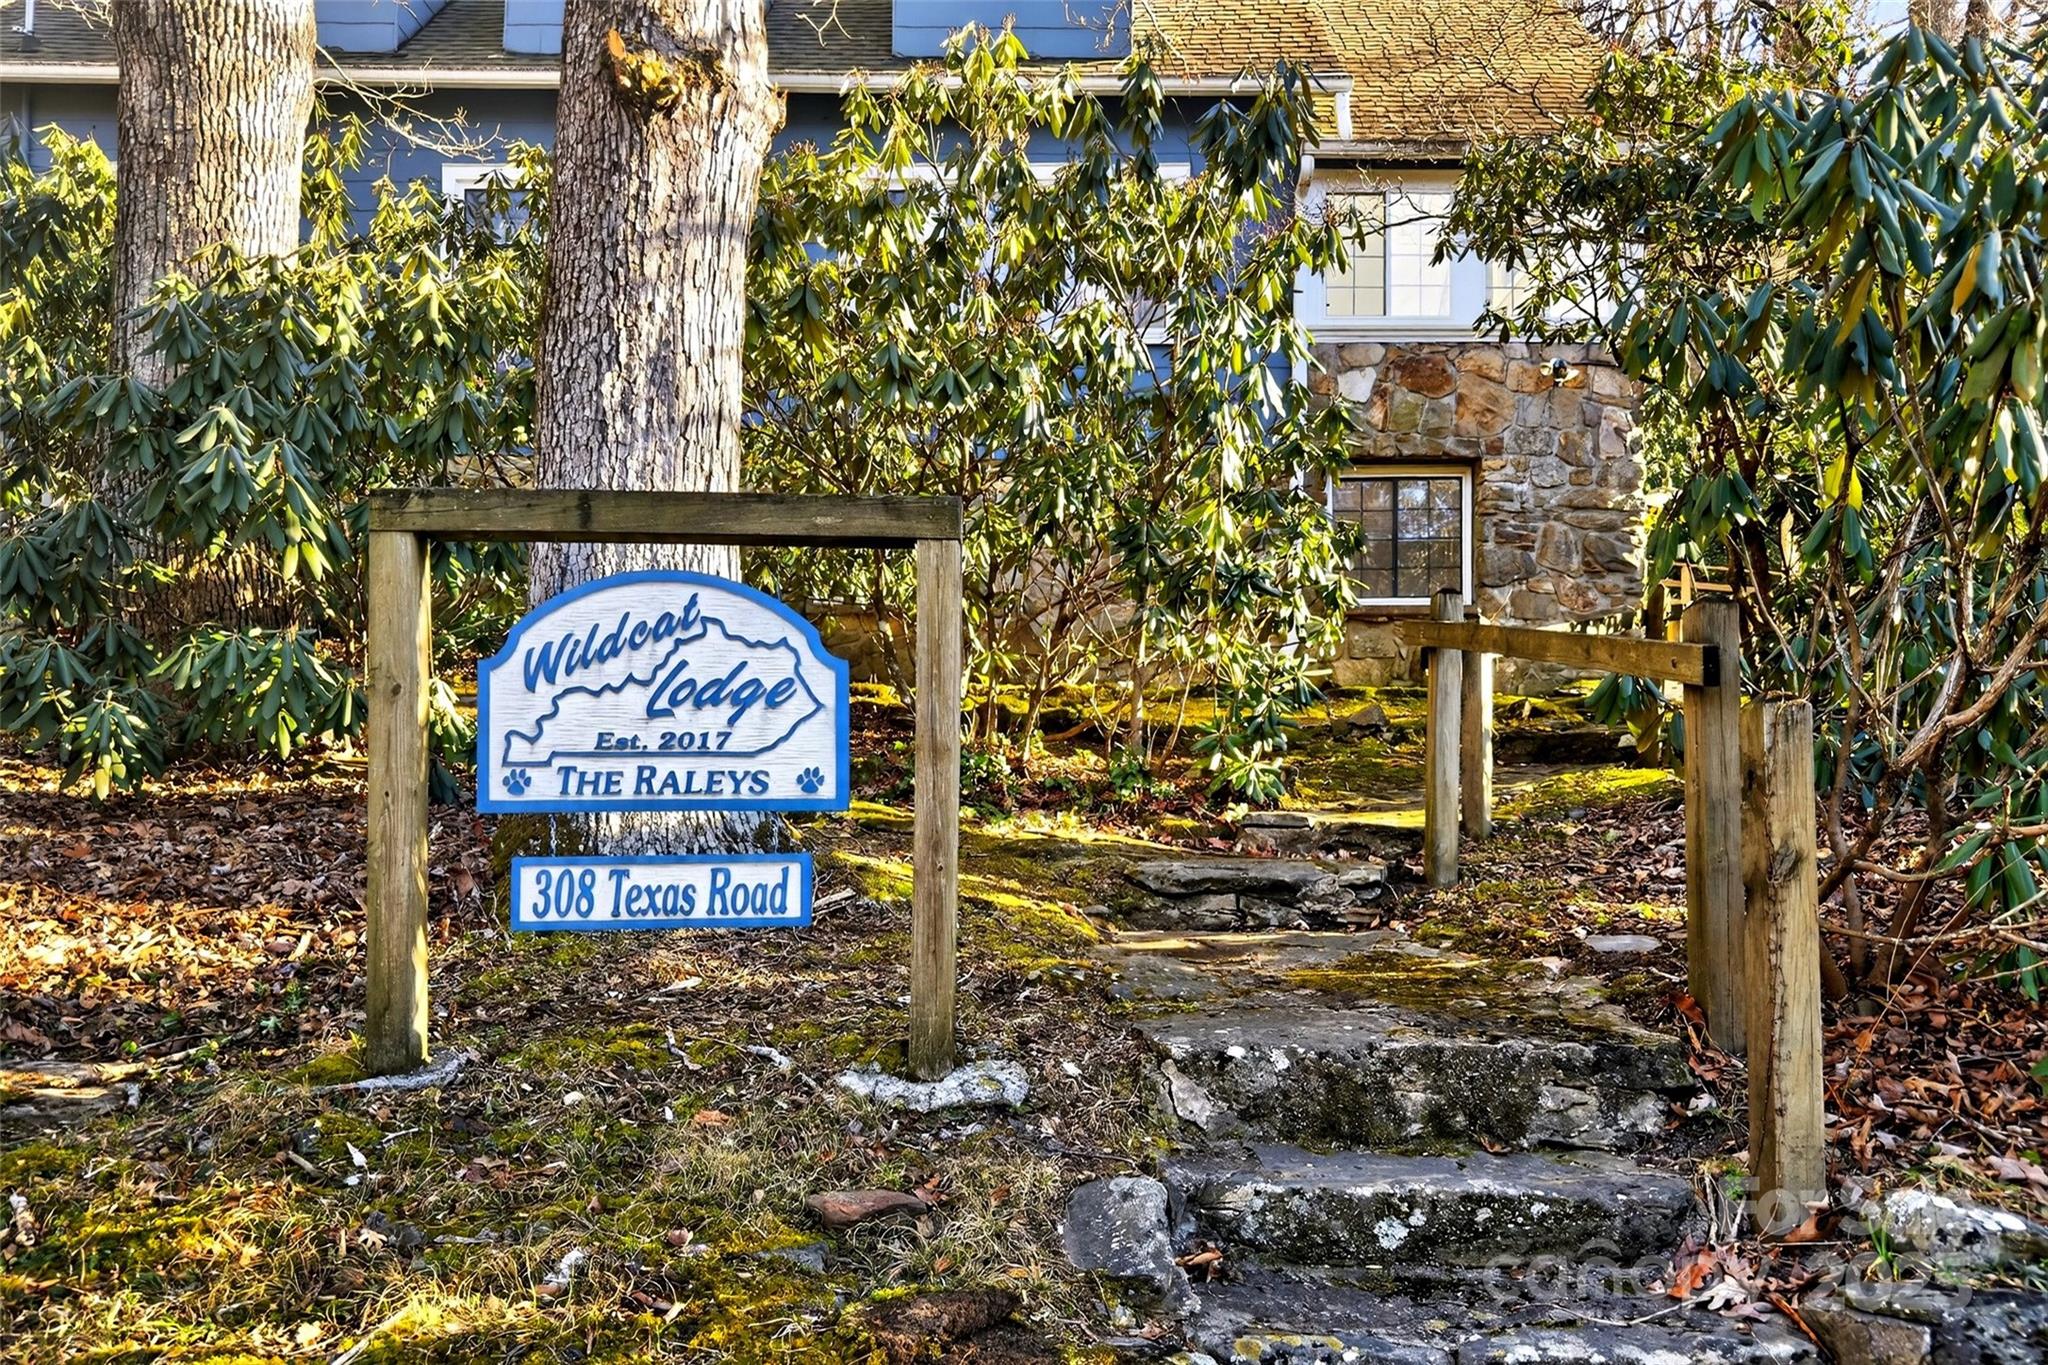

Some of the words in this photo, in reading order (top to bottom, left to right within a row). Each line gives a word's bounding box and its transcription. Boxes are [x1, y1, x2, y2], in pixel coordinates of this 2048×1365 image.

[523, 592, 701, 693] Wildcat
[645, 659, 798, 727] Lodge
[594, 732, 648, 751] Est.
[659, 731, 732, 751] 2017
[557, 765, 623, 796] THE
[634, 765, 770, 796] RALEYS
[532, 868, 596, 919] 308
[608, 868, 697, 918] Texas
[706, 866, 790, 917] Road
